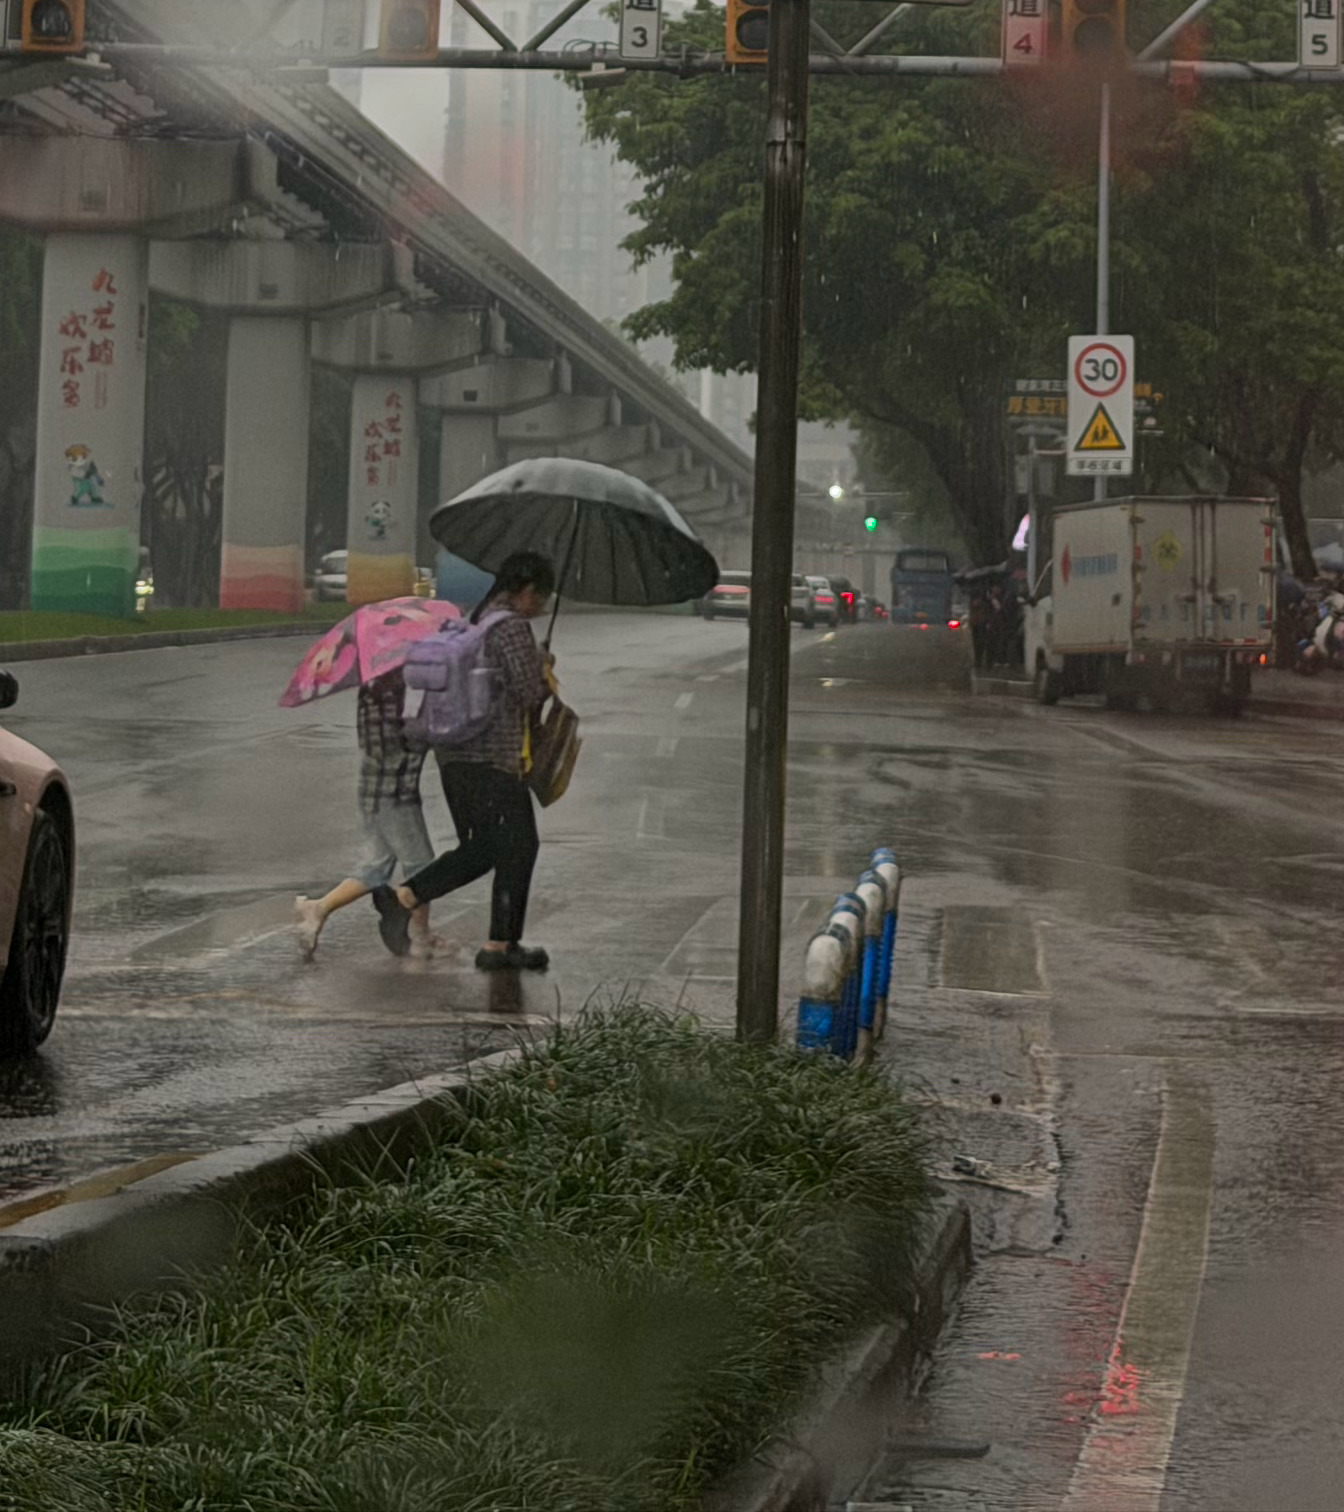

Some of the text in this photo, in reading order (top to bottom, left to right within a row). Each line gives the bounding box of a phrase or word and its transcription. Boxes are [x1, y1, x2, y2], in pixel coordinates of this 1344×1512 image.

[59, 311, 87, 408] 欢乐多
[87, 267, 117, 366] 九龙坡
[1083, 358, 1118, 381] 30
